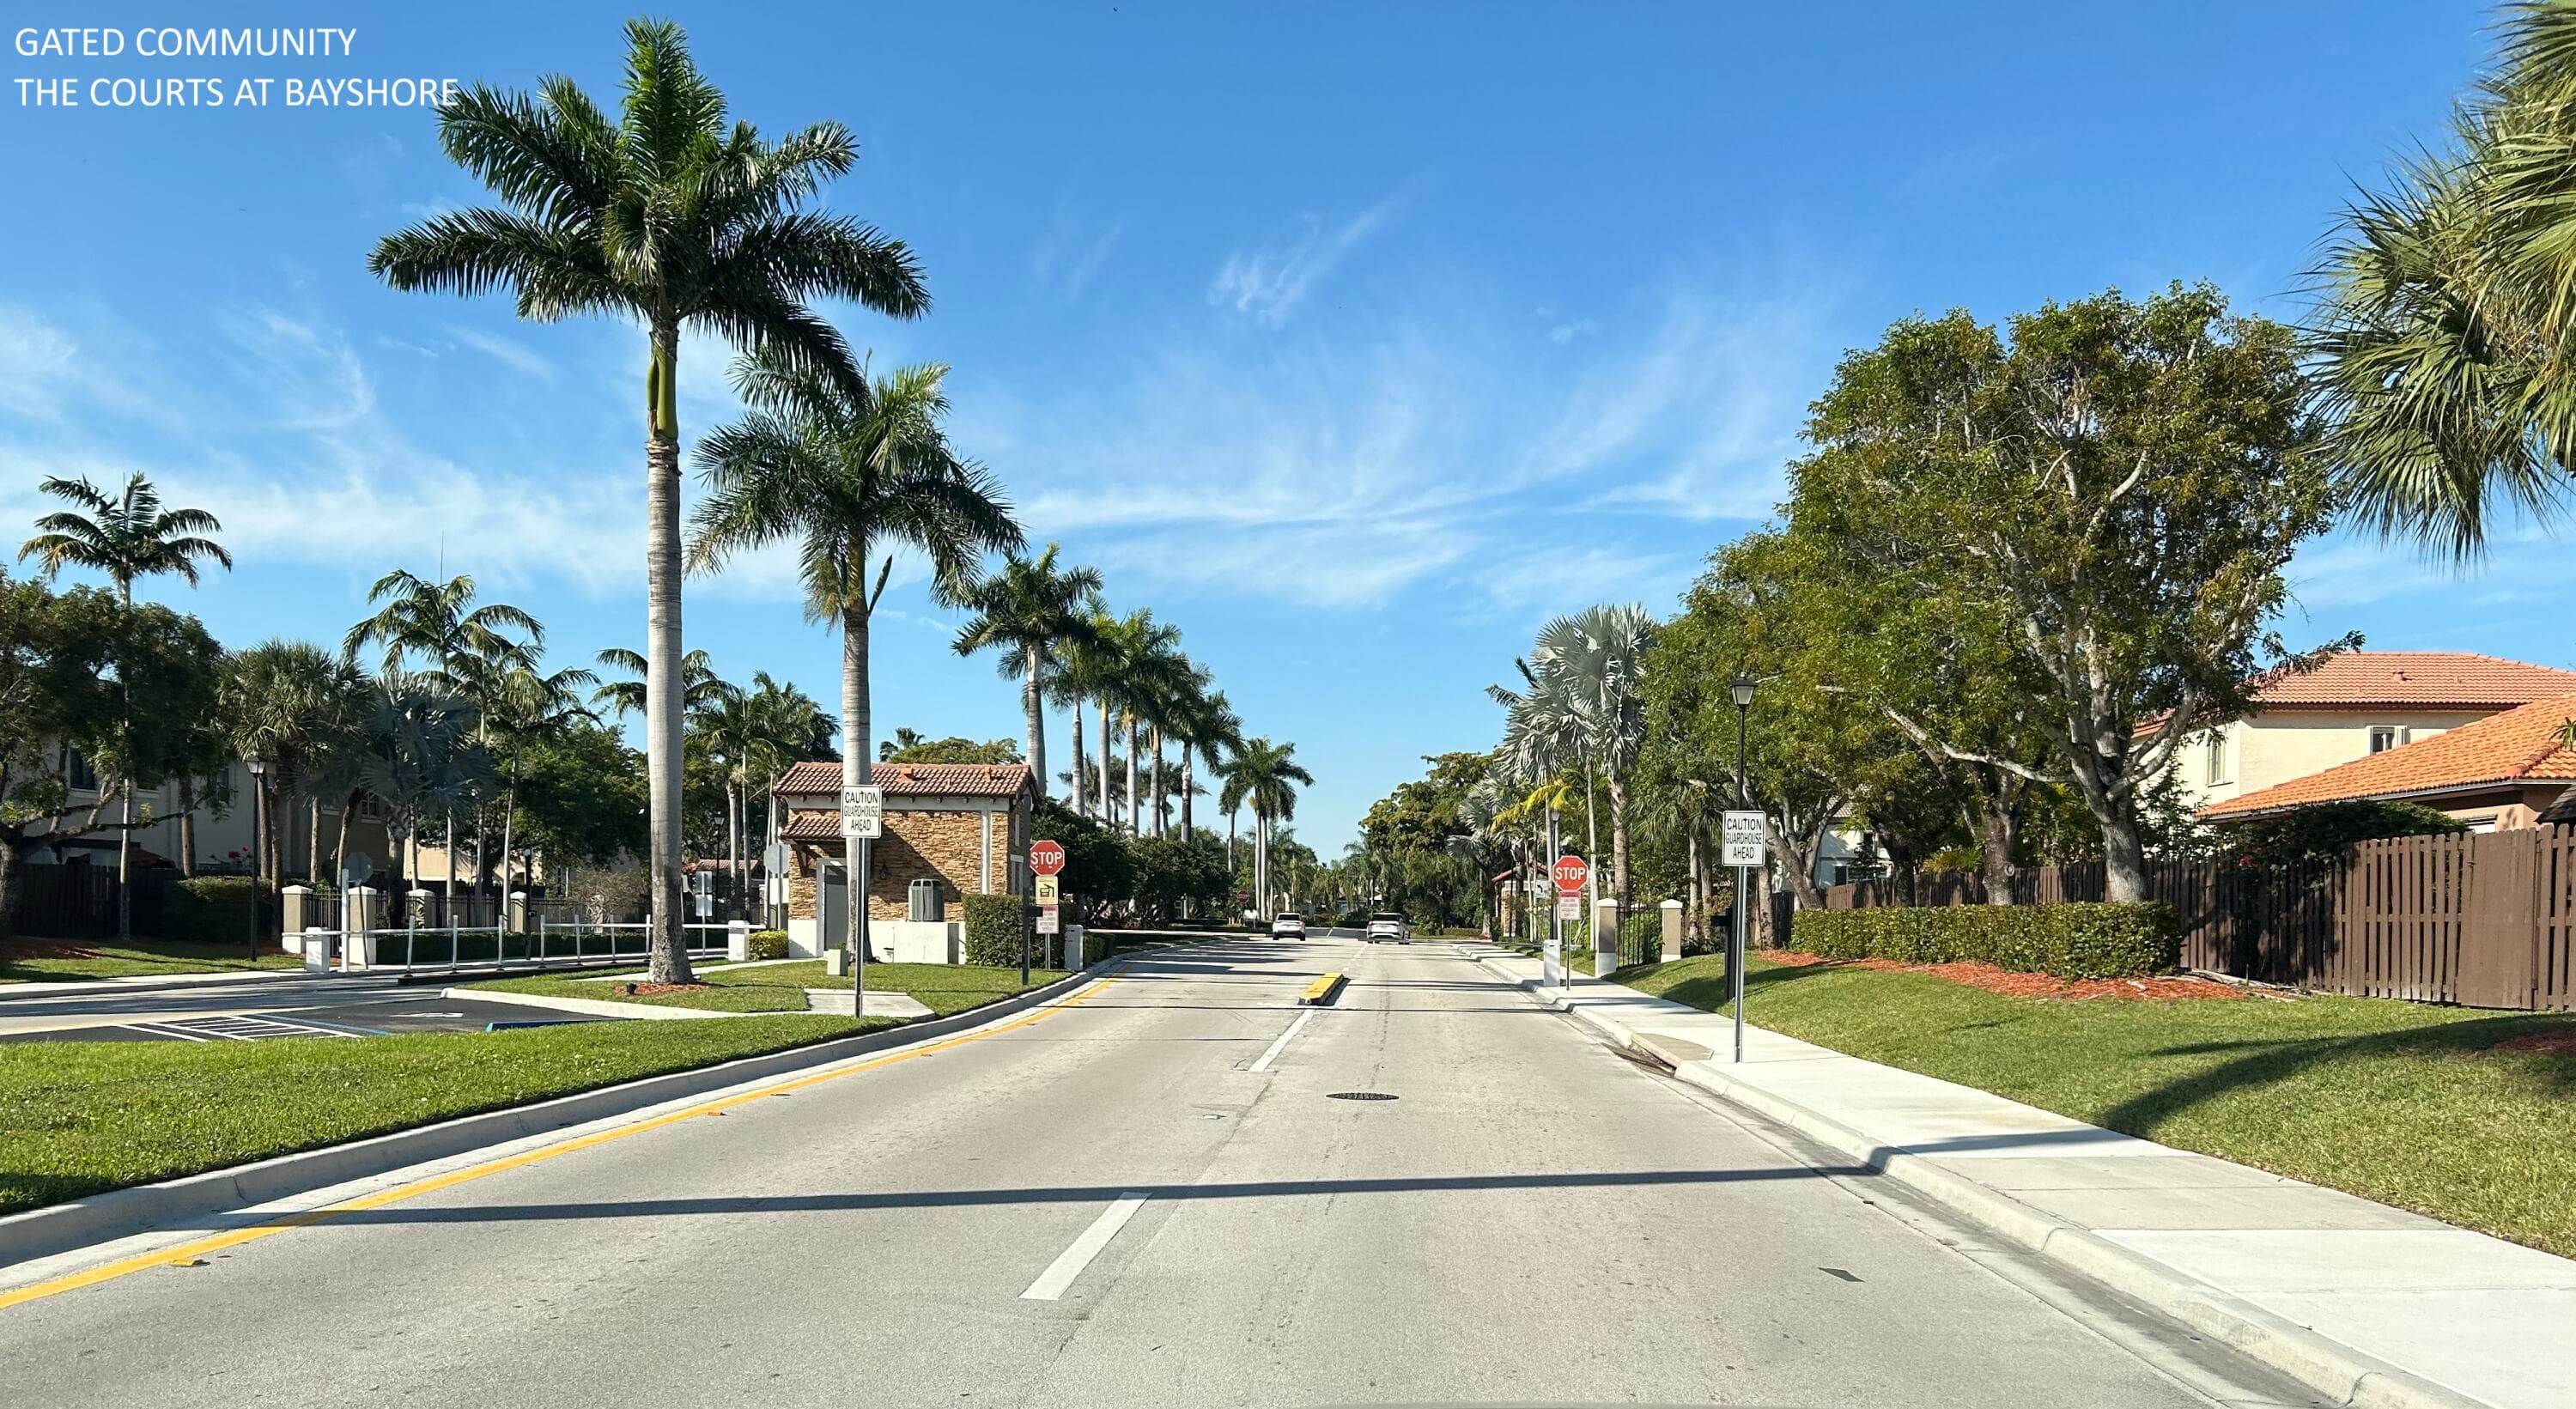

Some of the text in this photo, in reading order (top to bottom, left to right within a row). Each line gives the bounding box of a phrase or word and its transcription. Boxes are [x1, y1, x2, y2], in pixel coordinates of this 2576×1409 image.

[844, 792, 878, 804] CAUTION
[844, 805, 878, 817] GUARDHOUSE
[851, 819, 872, 831] AHEAD
[1727, 818, 1762, 830] CAUTION
[1726, 832, 1762, 845] GUARDHOUSE
[1030, 851, 1062, 865] STOP
[1733, 847, 1754, 859] AHEAD
[1555, 866, 1586, 881] STOP
